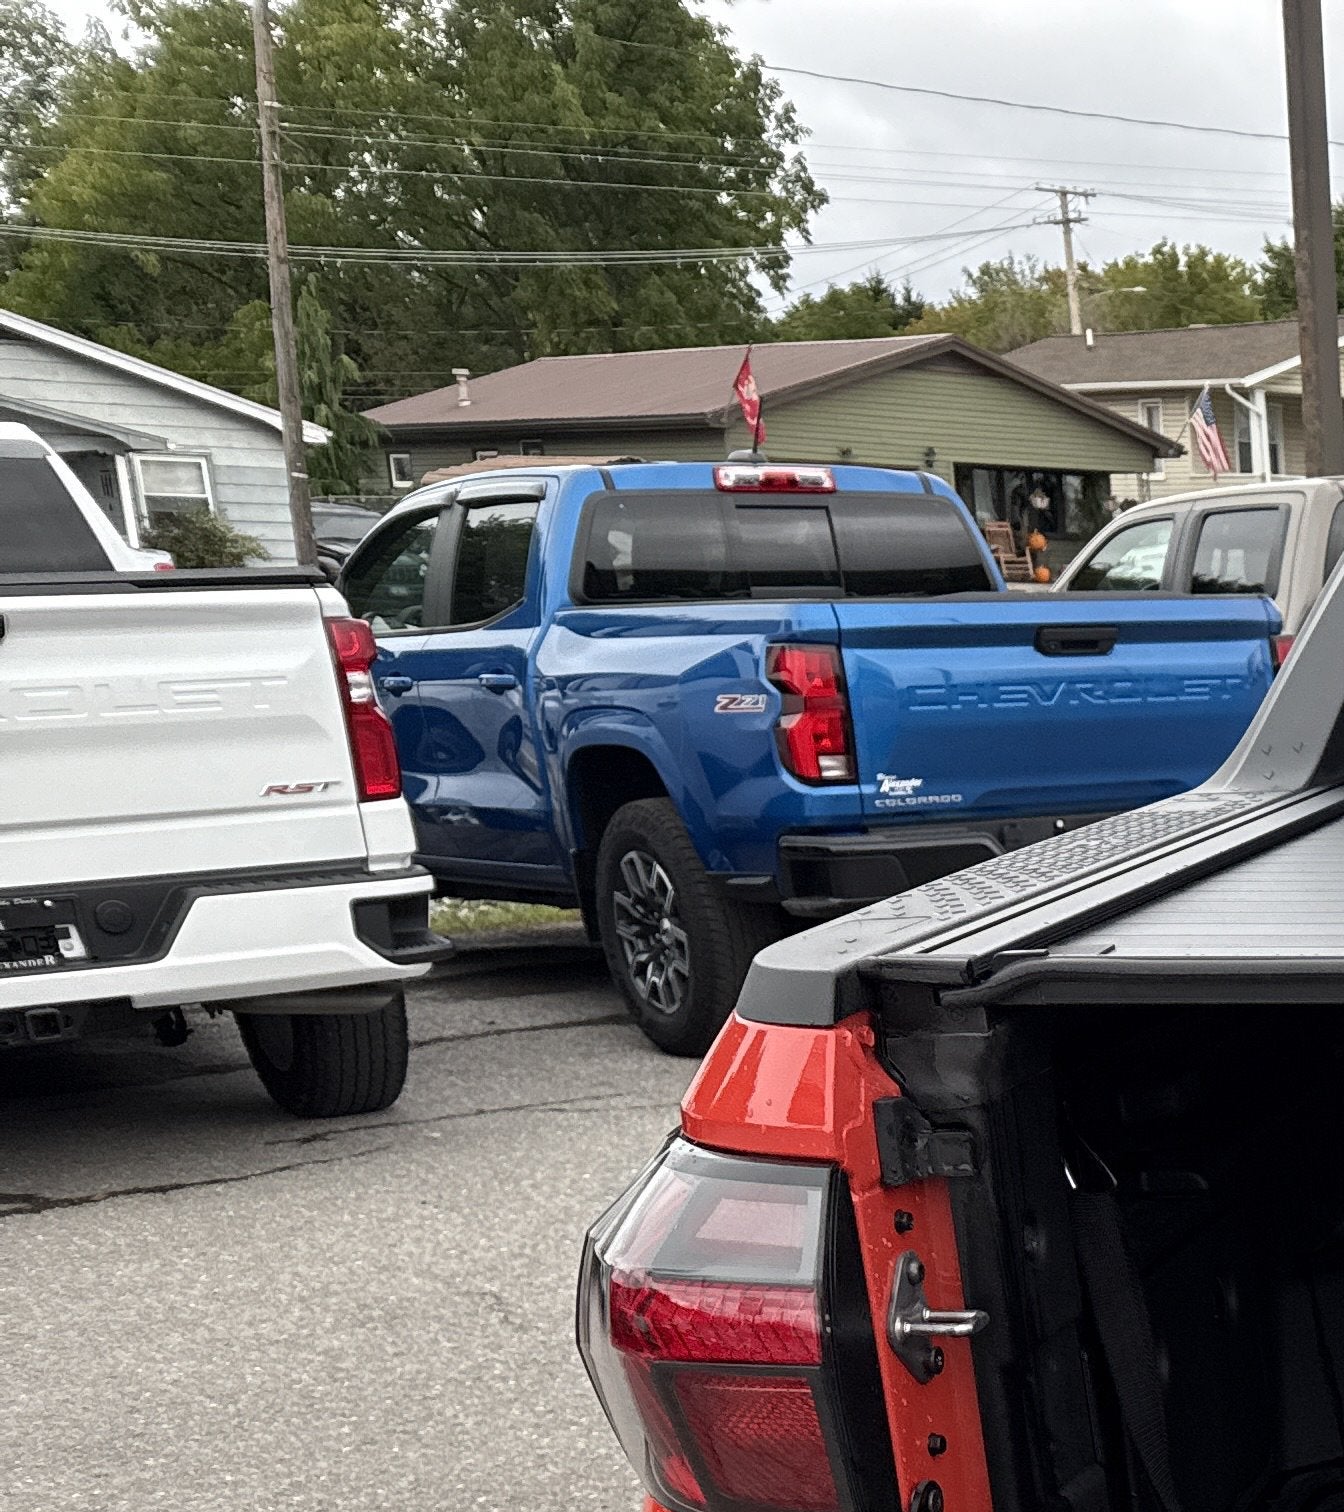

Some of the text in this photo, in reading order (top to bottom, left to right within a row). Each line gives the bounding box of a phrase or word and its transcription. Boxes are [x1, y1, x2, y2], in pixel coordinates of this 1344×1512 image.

[0, 676, 288, 721] OLET
[908, 675, 1245, 711] CHEVROLET
[714, 694, 767, 712] Z71
[259, 780, 342, 796] RST
[874, 794, 962, 807] COLORADO
[0, 955, 56, 969] XANDER
